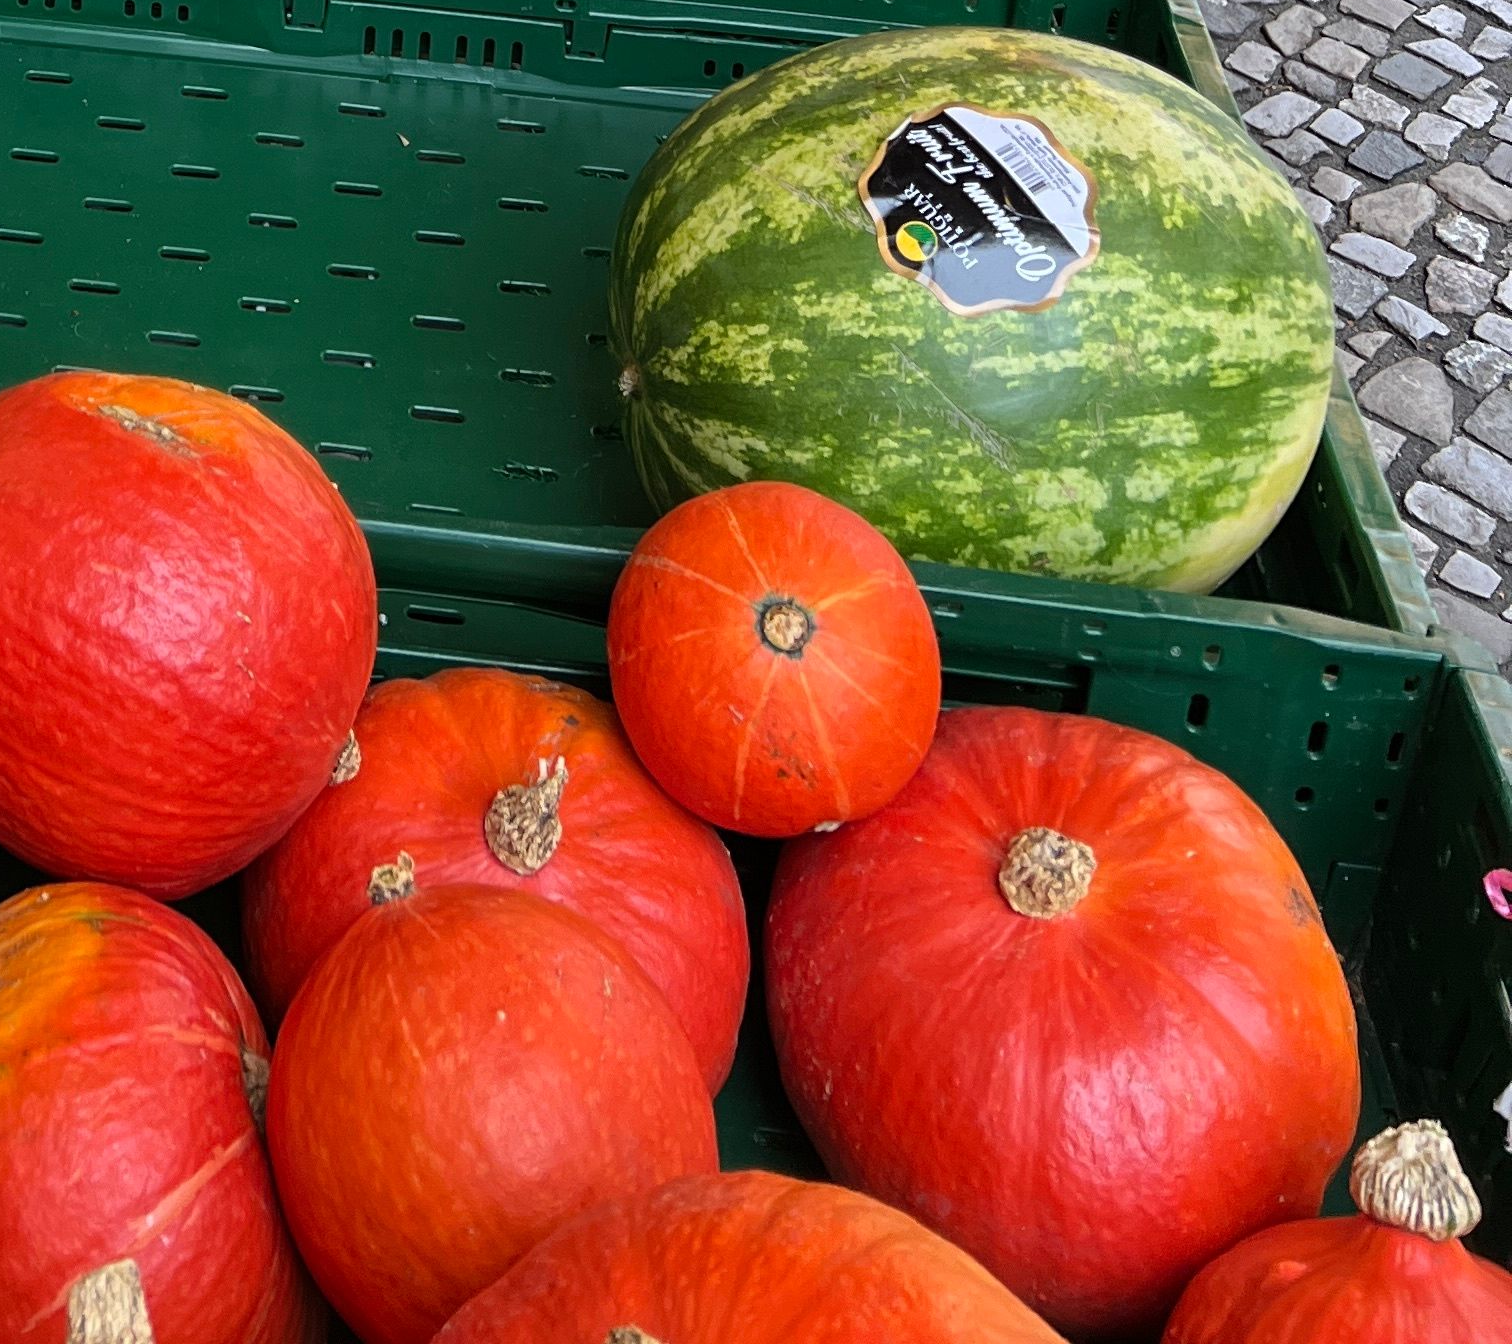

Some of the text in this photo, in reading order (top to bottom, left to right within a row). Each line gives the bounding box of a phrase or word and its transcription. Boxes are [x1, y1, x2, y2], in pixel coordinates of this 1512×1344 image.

[905, 129, 974, 184] Fruit
[902, 182, 978, 270] POTIGUAR
[963, 182, 1056, 282] Optimum
